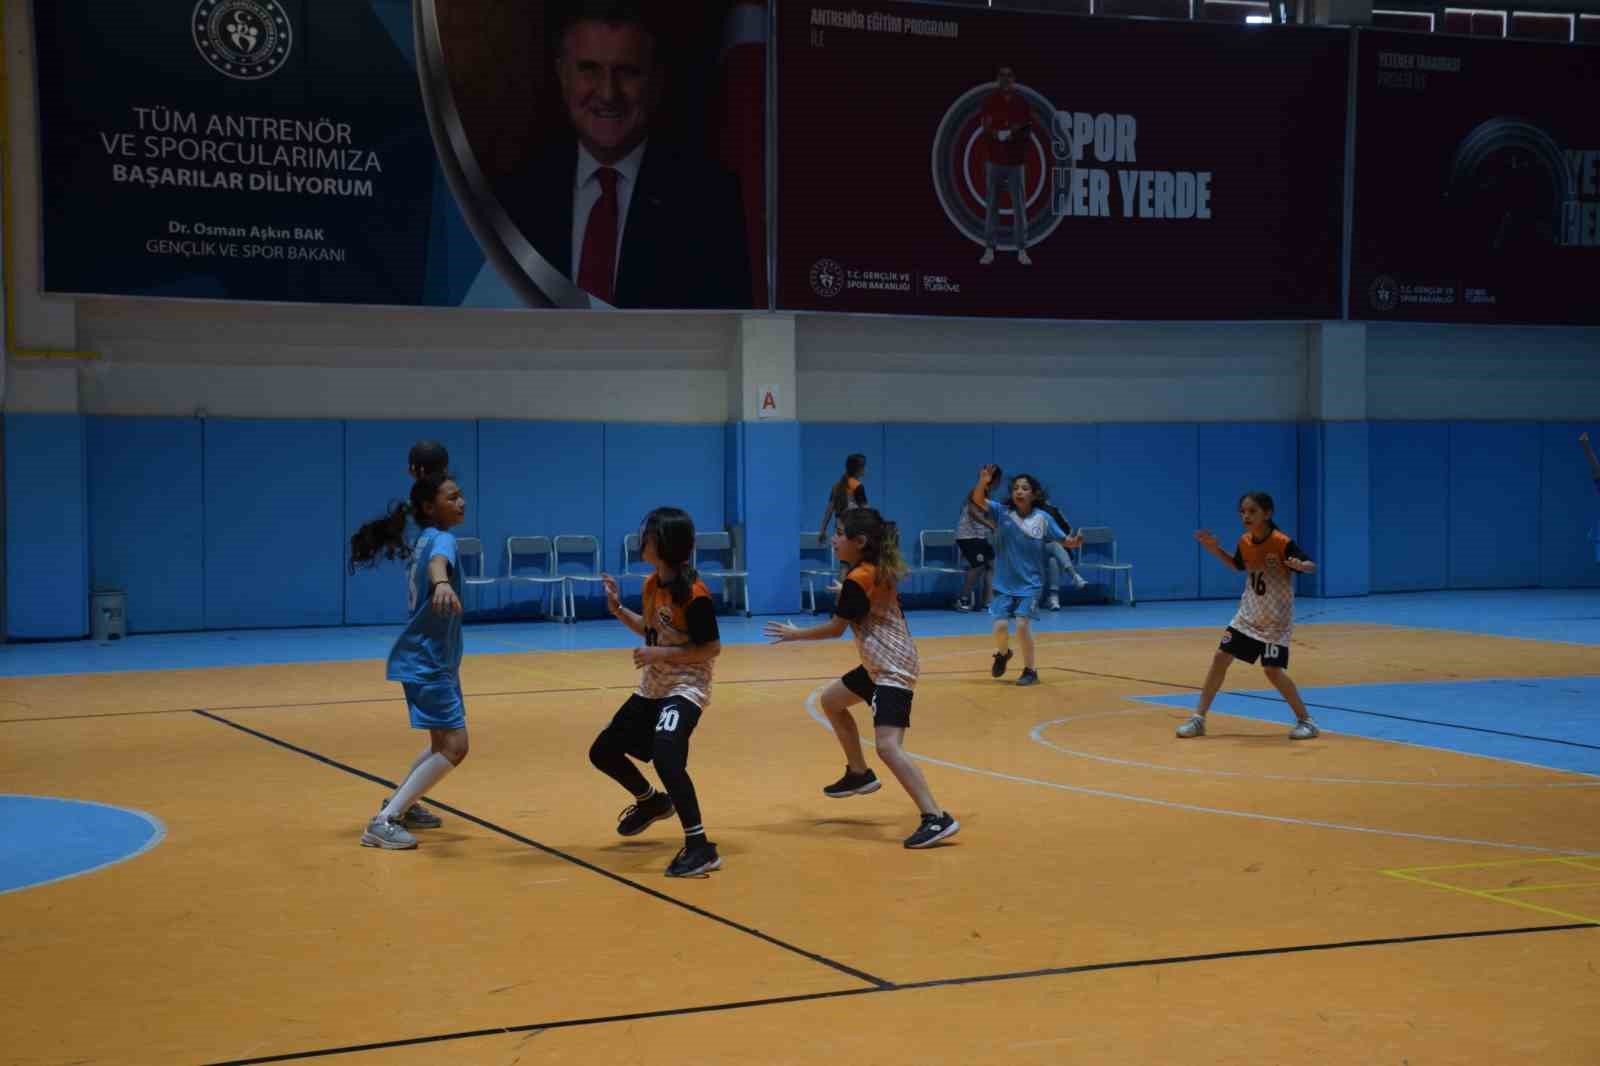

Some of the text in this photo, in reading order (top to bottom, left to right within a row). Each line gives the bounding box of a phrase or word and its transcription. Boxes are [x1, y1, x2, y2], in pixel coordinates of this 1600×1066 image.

[132, 104, 352, 145] TÜM ANTRENÖR
[1051, 111, 1136, 163] SPOR
[100, 131, 383, 173] VE SPORCULARIMIZA
[112, 163, 373, 197] BAŞARILAR DİLİYORUM
[1051, 167, 1212, 219] HER YERDE
[168, 220, 325, 243] Dr. Osman Aşkın BAK
[145, 239, 345, 262] GENÇLİK VE SPOR BAKANI
[762, 391, 777, 410] A
[1250, 571, 1266, 596] 16
[1263, 642, 1279, 659] 16
[656, 708, 680, 732] 20
